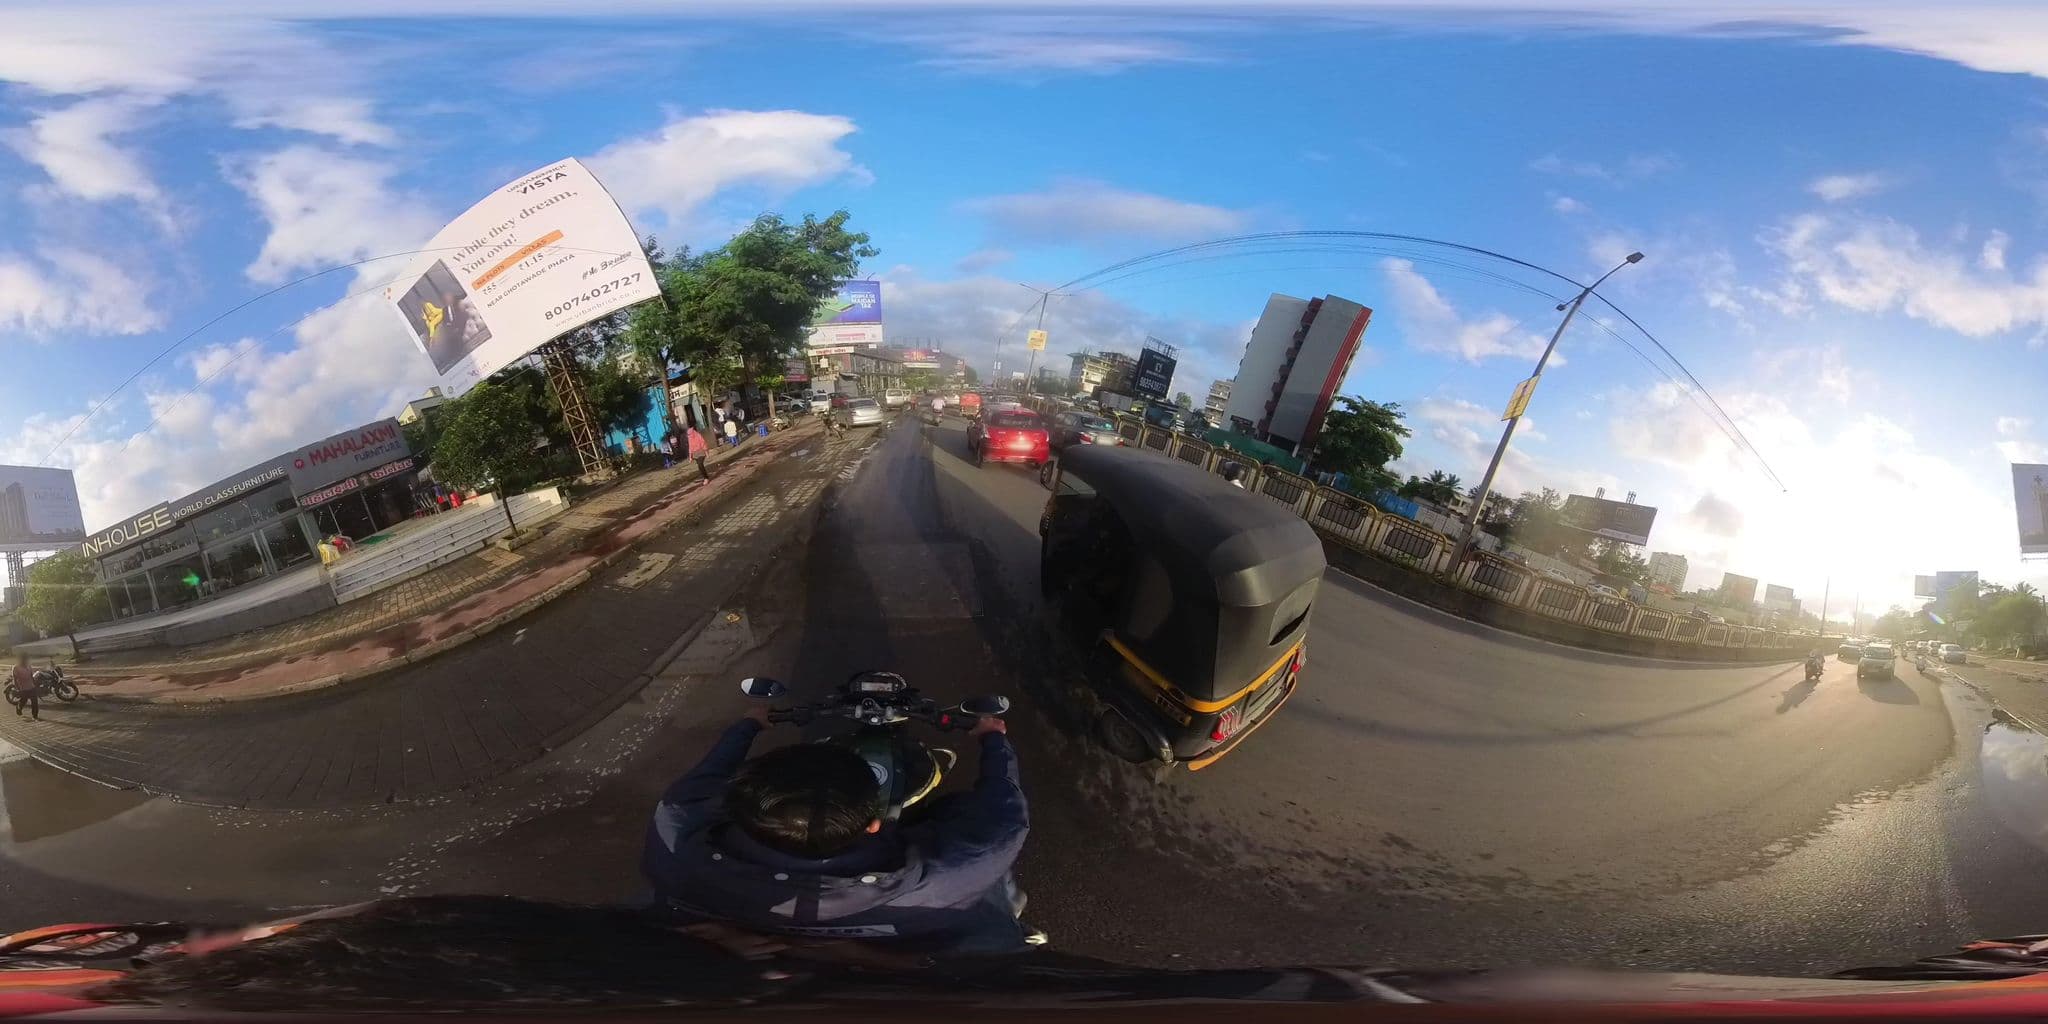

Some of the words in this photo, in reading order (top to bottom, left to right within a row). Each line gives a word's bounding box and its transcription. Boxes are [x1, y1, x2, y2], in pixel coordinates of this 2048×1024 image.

[517, 172, 567, 194] VISTA
[453, 236, 488, 262] While
[488, 217, 516, 239] they
[519, 191, 578, 219] dream,
[462, 257, 486, 275] You
[487, 233, 517, 258] own!
[487, 295, 503, 308] NEAR
[503, 268, 547, 297] GHOTAWADE
[547, 254, 576, 270] PHATA
[544, 272, 641, 320] 8007402727
[308, 424, 397, 466] MAHALAXMI
[353, 440, 402, 463] FURNITURE
[171, 501, 203, 519] WORLD
[81, 506, 172, 558] INHOUSE
